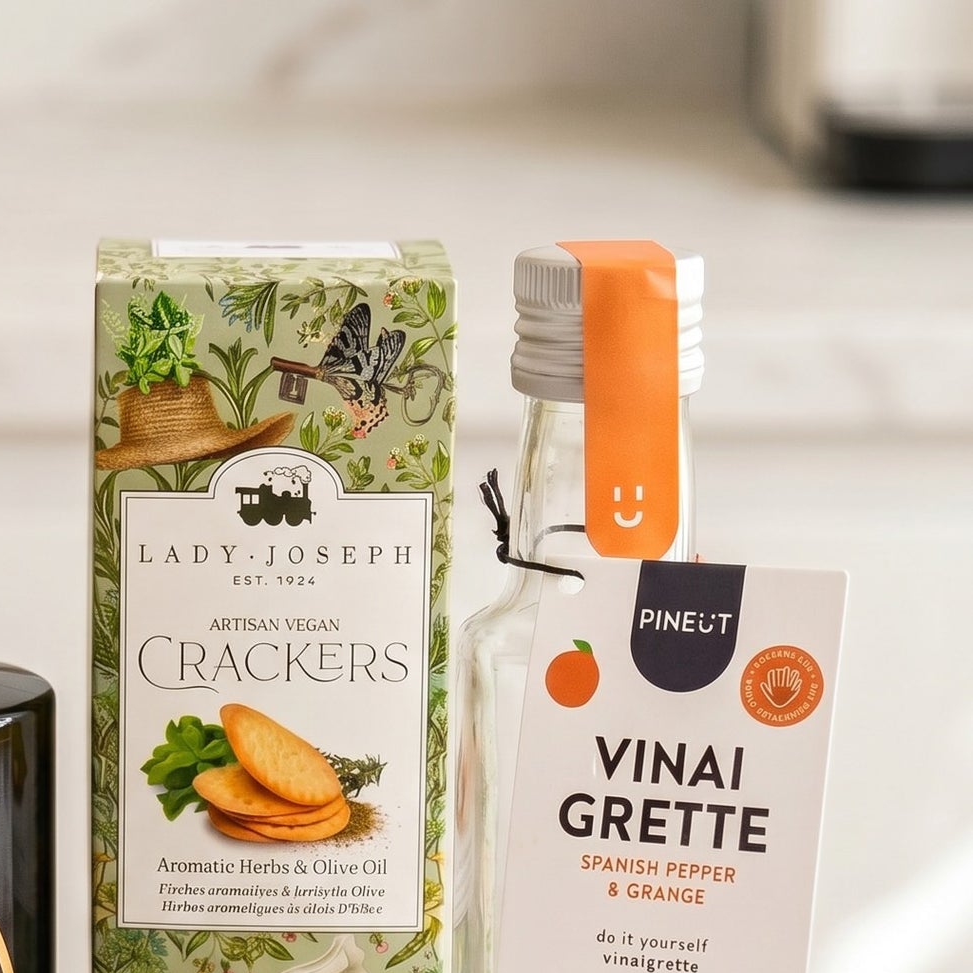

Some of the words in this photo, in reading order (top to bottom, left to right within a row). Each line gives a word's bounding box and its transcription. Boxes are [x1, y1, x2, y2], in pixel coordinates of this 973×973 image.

[138, 544, 238, 564] LADY
[265, 545, 412, 567] JOSEPH
[233, 575, 268, 586] EST.
[276, 575, 316, 586] 1924
[209, 618, 280, 632] ARTISAN
[285, 618, 340, 632] VEGAN
[595, 735, 744, 790] VINAI
[558, 793, 770, 853] GRETTE
[157, 857, 235, 874] Aromatic
[239, 858, 290, 875] Herbs
[294, 860, 308, 875] &
[313, 858, 358, 875] Olive
[362, 858, 388, 875] Oil
[581, 855, 658, 876] SPANISH
[666, 862, 736, 883] PEPPER
[282, 886, 291, 897] &
[351, 885, 385, 897] Olive
[608, 882, 618, 897] &
[626, 884, 705, 904] GRANGE
[596, 929, 615, 945] do
[622, 931, 633, 946] it
[640, 935, 708, 953] yourself
[603, 952, 699, 973] vinaigrette
